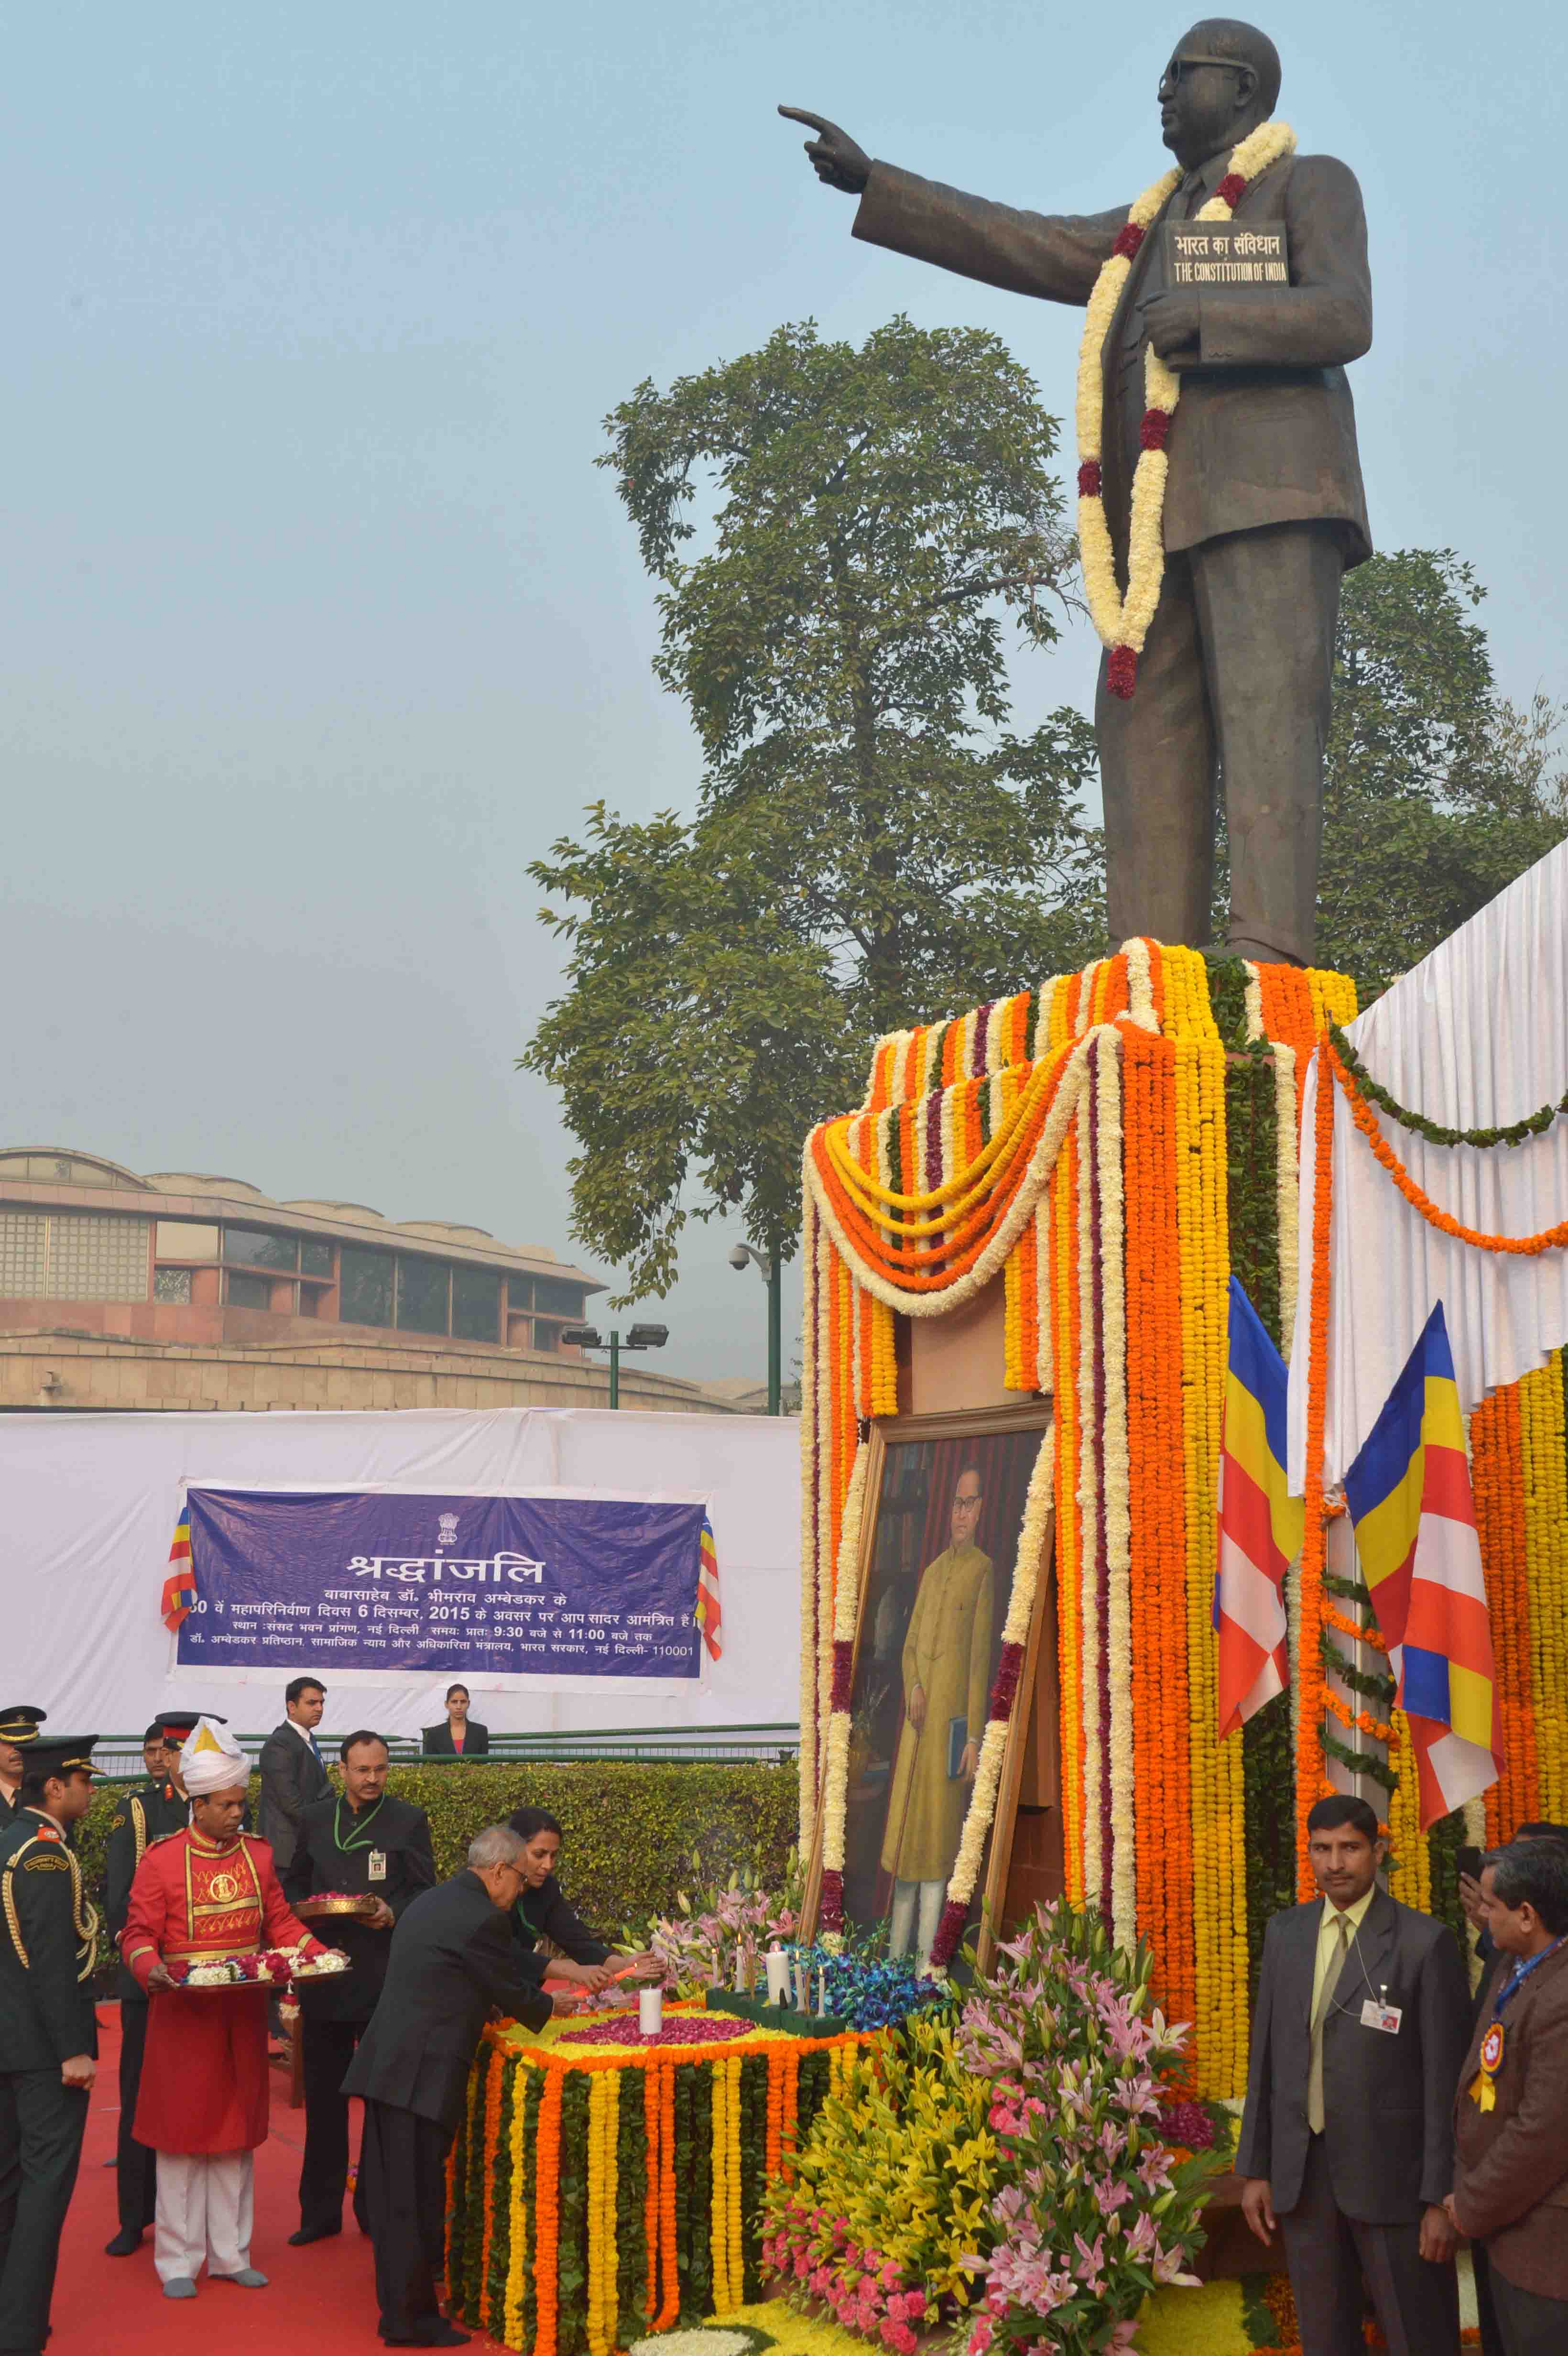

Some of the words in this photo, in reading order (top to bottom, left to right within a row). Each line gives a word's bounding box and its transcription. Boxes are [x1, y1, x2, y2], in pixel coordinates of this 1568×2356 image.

[1175, 237, 1209, 255] भारत
[1212, 237, 1230, 255] का
[1234, 233, 1280, 254] संविधान
[1174, 263, 1193, 282] THE
[1194, 262, 1253, 282] CONSTITUTION
[1253, 262, 1263, 282] OF
[1265, 262, 1286, 282] INDIA
[346, 1549, 546, 1583] श्रद्धांजलि
[324, 1587, 390, 1601] बाबासाहेब
[428, 1589, 476, 1603] भीमराव
[484, 1591, 545, 1605] अम्बेडकर
[553, 1592, 567, 1605] के
[215, 1600, 225, 1614] वें
[230, 1602, 310, 1616] महापरिनिर्वाण
[317, 1603, 351, 1617] दिवस
[358, 1604, 368, 1618] 6
[373, 1605, 423, 1620] दिसम्बर,
[429, 1606, 470, 1620] 2015
[474, 1607, 487, 1621] के
[493, 1611, 532, 1622] अवसर
[538, 1612, 555, 1623] पर
[561, 1613, 585, 1624] आप
[588, 1614, 620, 1625] सादर
[627, 1612, 675, 1626] आमंत्रित
[232, 1621, 257, 1630] स्थान
[299, 1624, 322, 1632] भवन
[367, 1623, 382, 1635] नई
[389, 1624, 419, 1635] दिल्ली
[494, 1626, 523, 1638] 9:30
[529, 1628, 547, 1638] बजे
[552, 1628, 562, 1639] से
[568, 1629, 605, 1640] 11:00
[611, 1630, 629, 1641] बजे
[634, 1632, 653, 1641] तक
[210, 1633, 256, 1645] अम्बेडकर
[311, 1636, 358, 1647] सामाजिक
[363, 1639, 386, 1648] न्याय
[392, 1637, 411, 1648] और
[416, 1638, 470, 1650] अधिकारिता
[520, 1643, 546, 1652] भारत
[550, 1644, 588, 1654] सरकार,
[594, 1643, 610, 1655] नई
[653, 1646, 693, 1657] 110001
